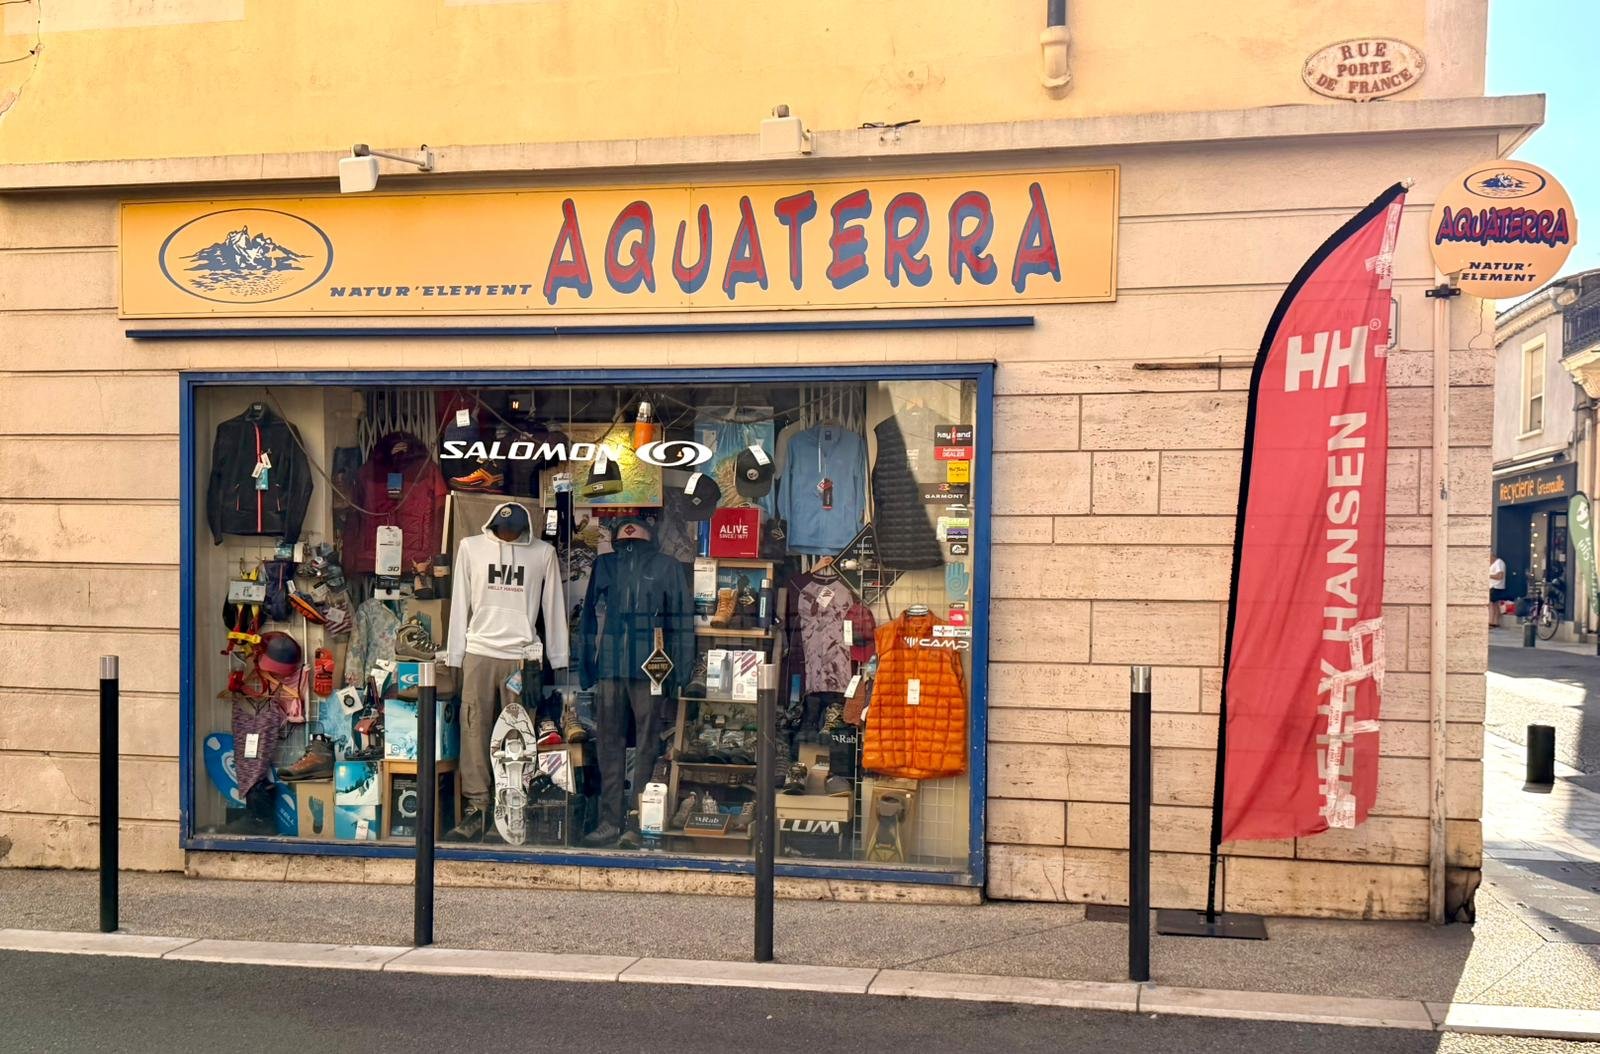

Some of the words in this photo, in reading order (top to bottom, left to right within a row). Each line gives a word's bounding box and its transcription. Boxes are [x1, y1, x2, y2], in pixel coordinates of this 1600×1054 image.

[1340, 42, 1387, 60] RUE
[1337, 60, 1391, 77] PORTE
[1316, 74, 1338, 91] DE
[1348, 68, 1413, 93] FRANCE
[1435, 205, 1569, 248] AQUATERRA
[543, 182, 1062, 305] AQUATERRA
[1460, 273, 1537, 281] ELEMENT
[1469, 262, 1532, 271] NATUR'
[1284, 325, 1368, 392] HH
[440, 441, 620, 461] SALOMON
[720, 525, 749, 534] ALIVE
[1322, 411, 1367, 642] HANSEN
[488, 564, 525, 586] HH
